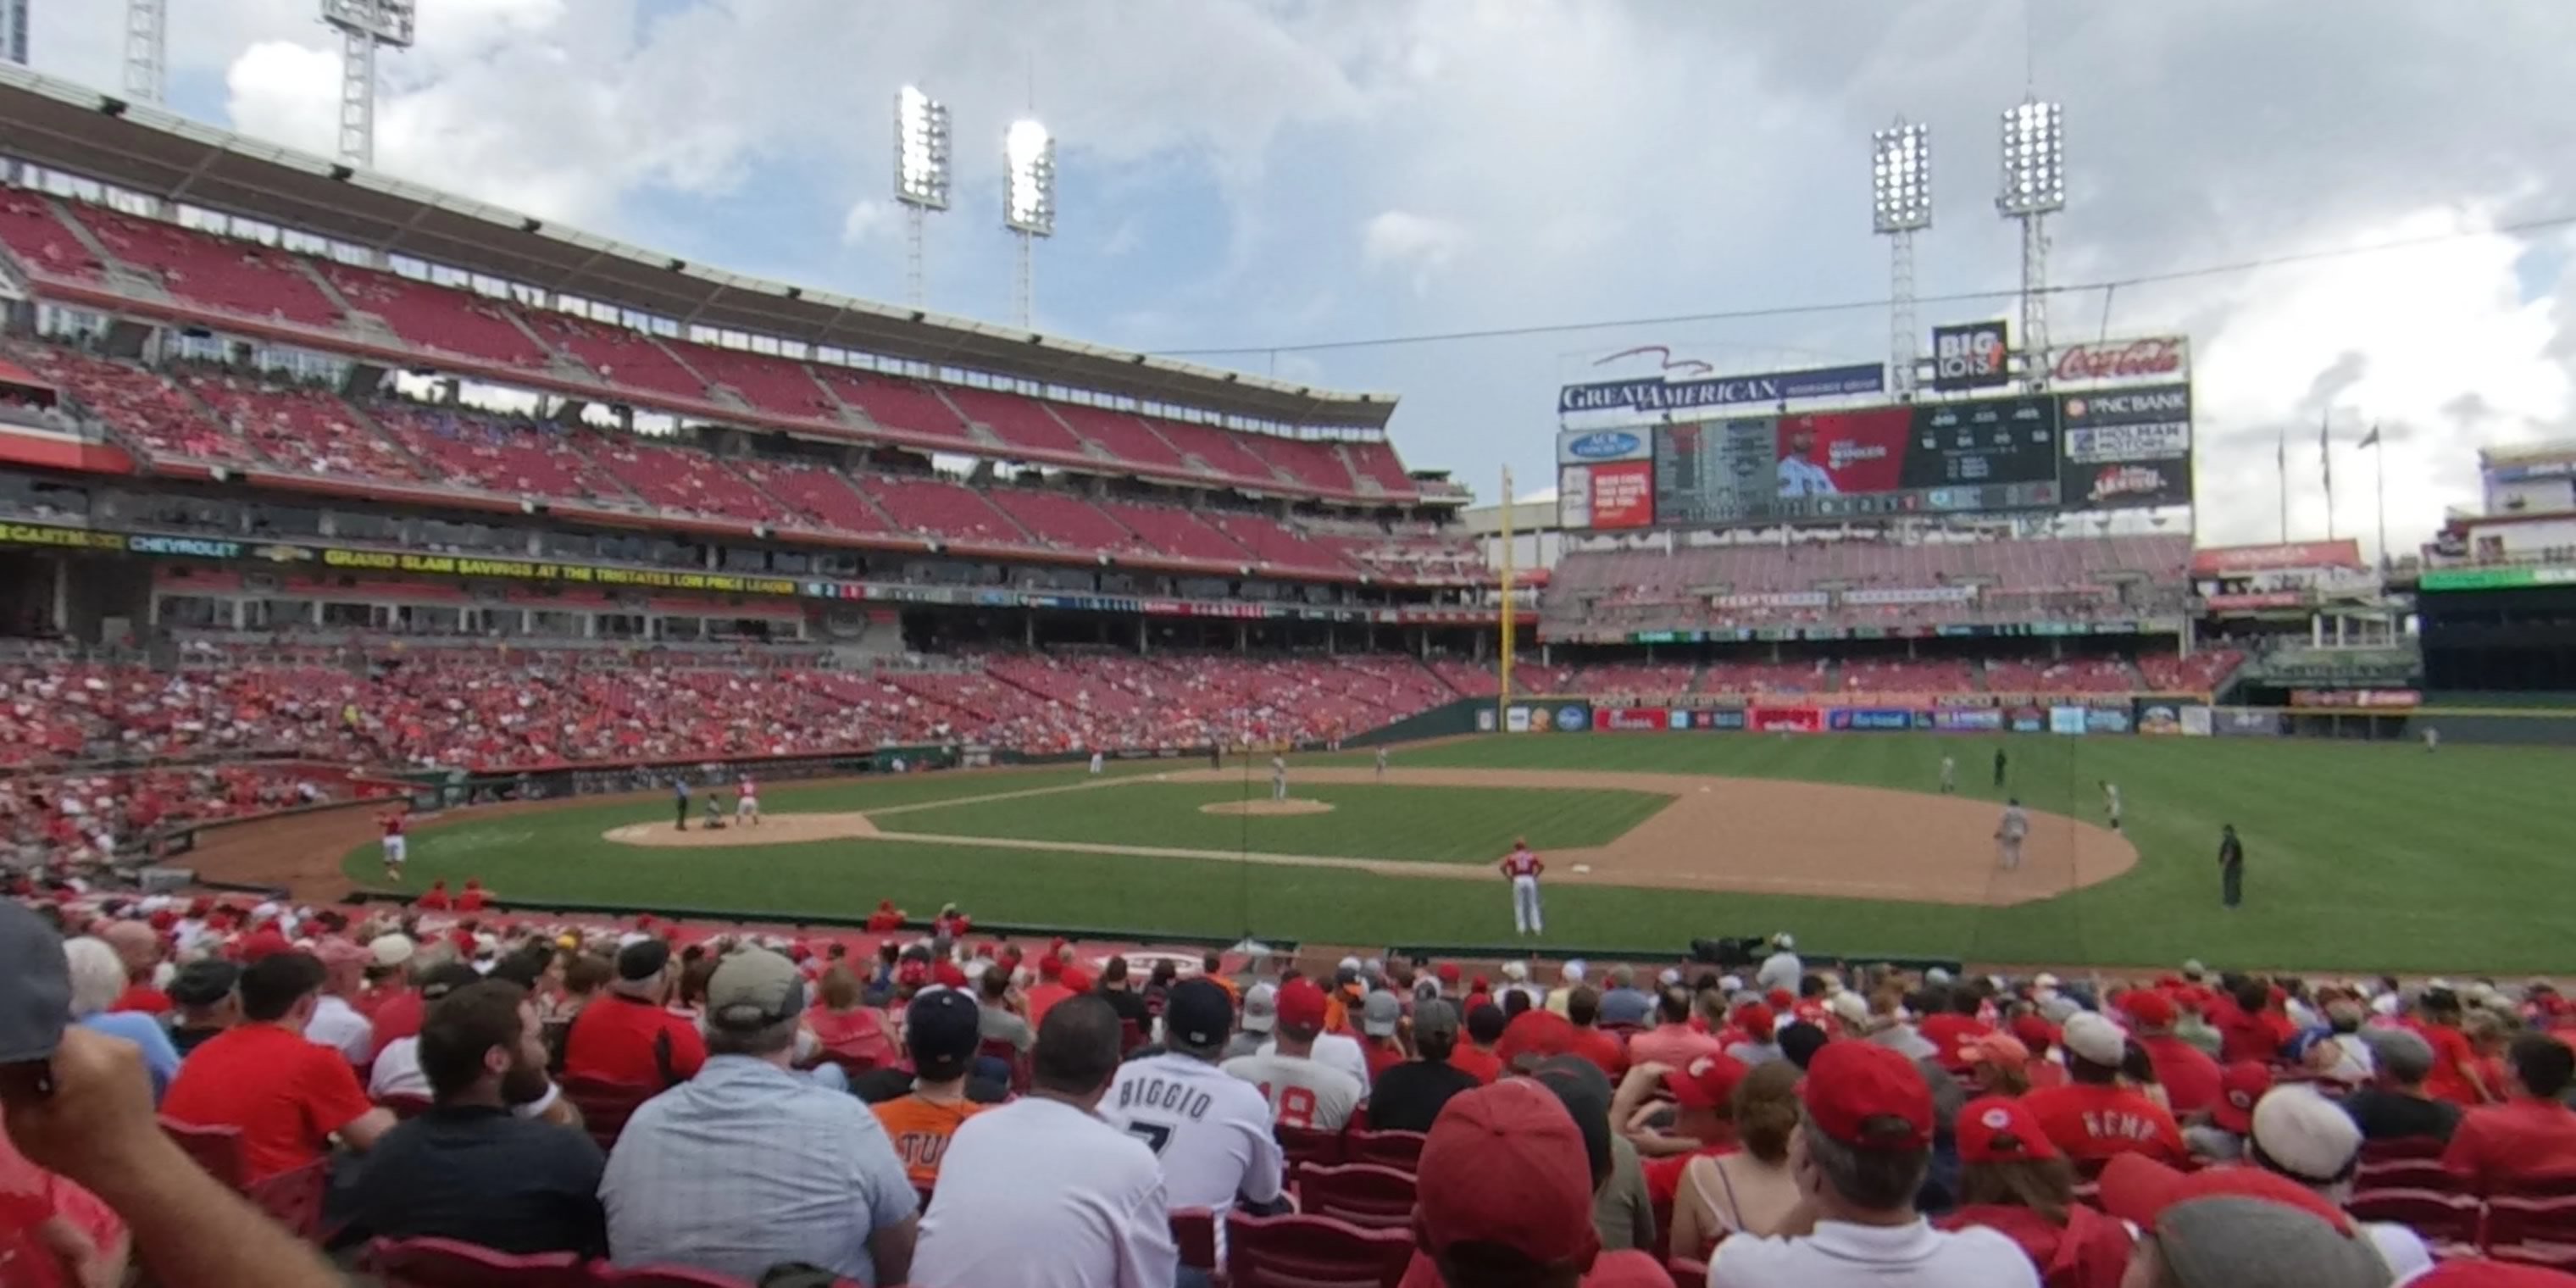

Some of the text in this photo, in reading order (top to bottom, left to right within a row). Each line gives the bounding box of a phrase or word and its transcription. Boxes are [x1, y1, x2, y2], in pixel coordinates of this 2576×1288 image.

[1940, 331, 1997, 358] BIG
[2056, 339, 2179, 380] Coca-Cola
[2089, 392, 2186, 414] PNC BANK
[129, 536, 238, 557] CHEVROLET
[325, 551, 397, 569] GRAND
[401, 555, 454, 571] SLAM
[536, 563, 559, 577] AT
[563, 565, 592, 581] THE
[1119, 1076, 1213, 1119] BIGGIO
[1127, 1119, 1177, 1160] 7
[2081, 1108, 2158, 1141] KEMP
